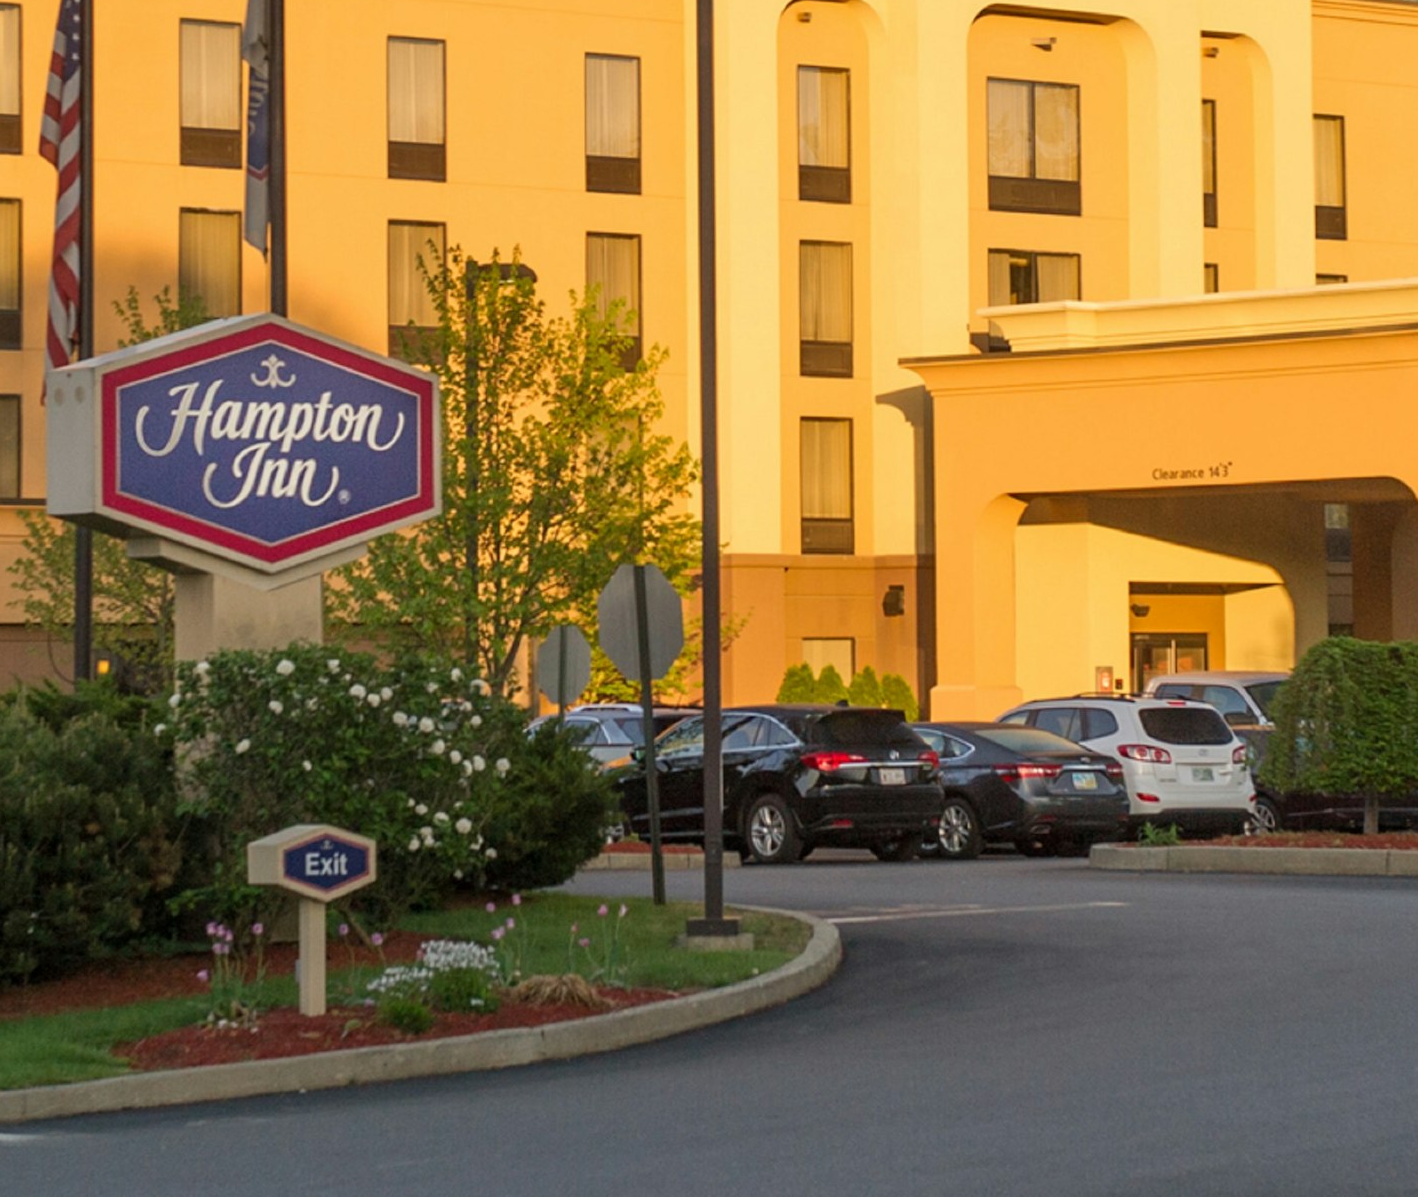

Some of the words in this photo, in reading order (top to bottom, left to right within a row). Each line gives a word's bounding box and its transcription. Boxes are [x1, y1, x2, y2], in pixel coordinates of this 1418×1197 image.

[135, 379, 405, 457] Hampton
[202, 442, 339, 508] Inn
[1152, 468, 1204, 480] Clearance
[305, 853, 348, 876] Exit
